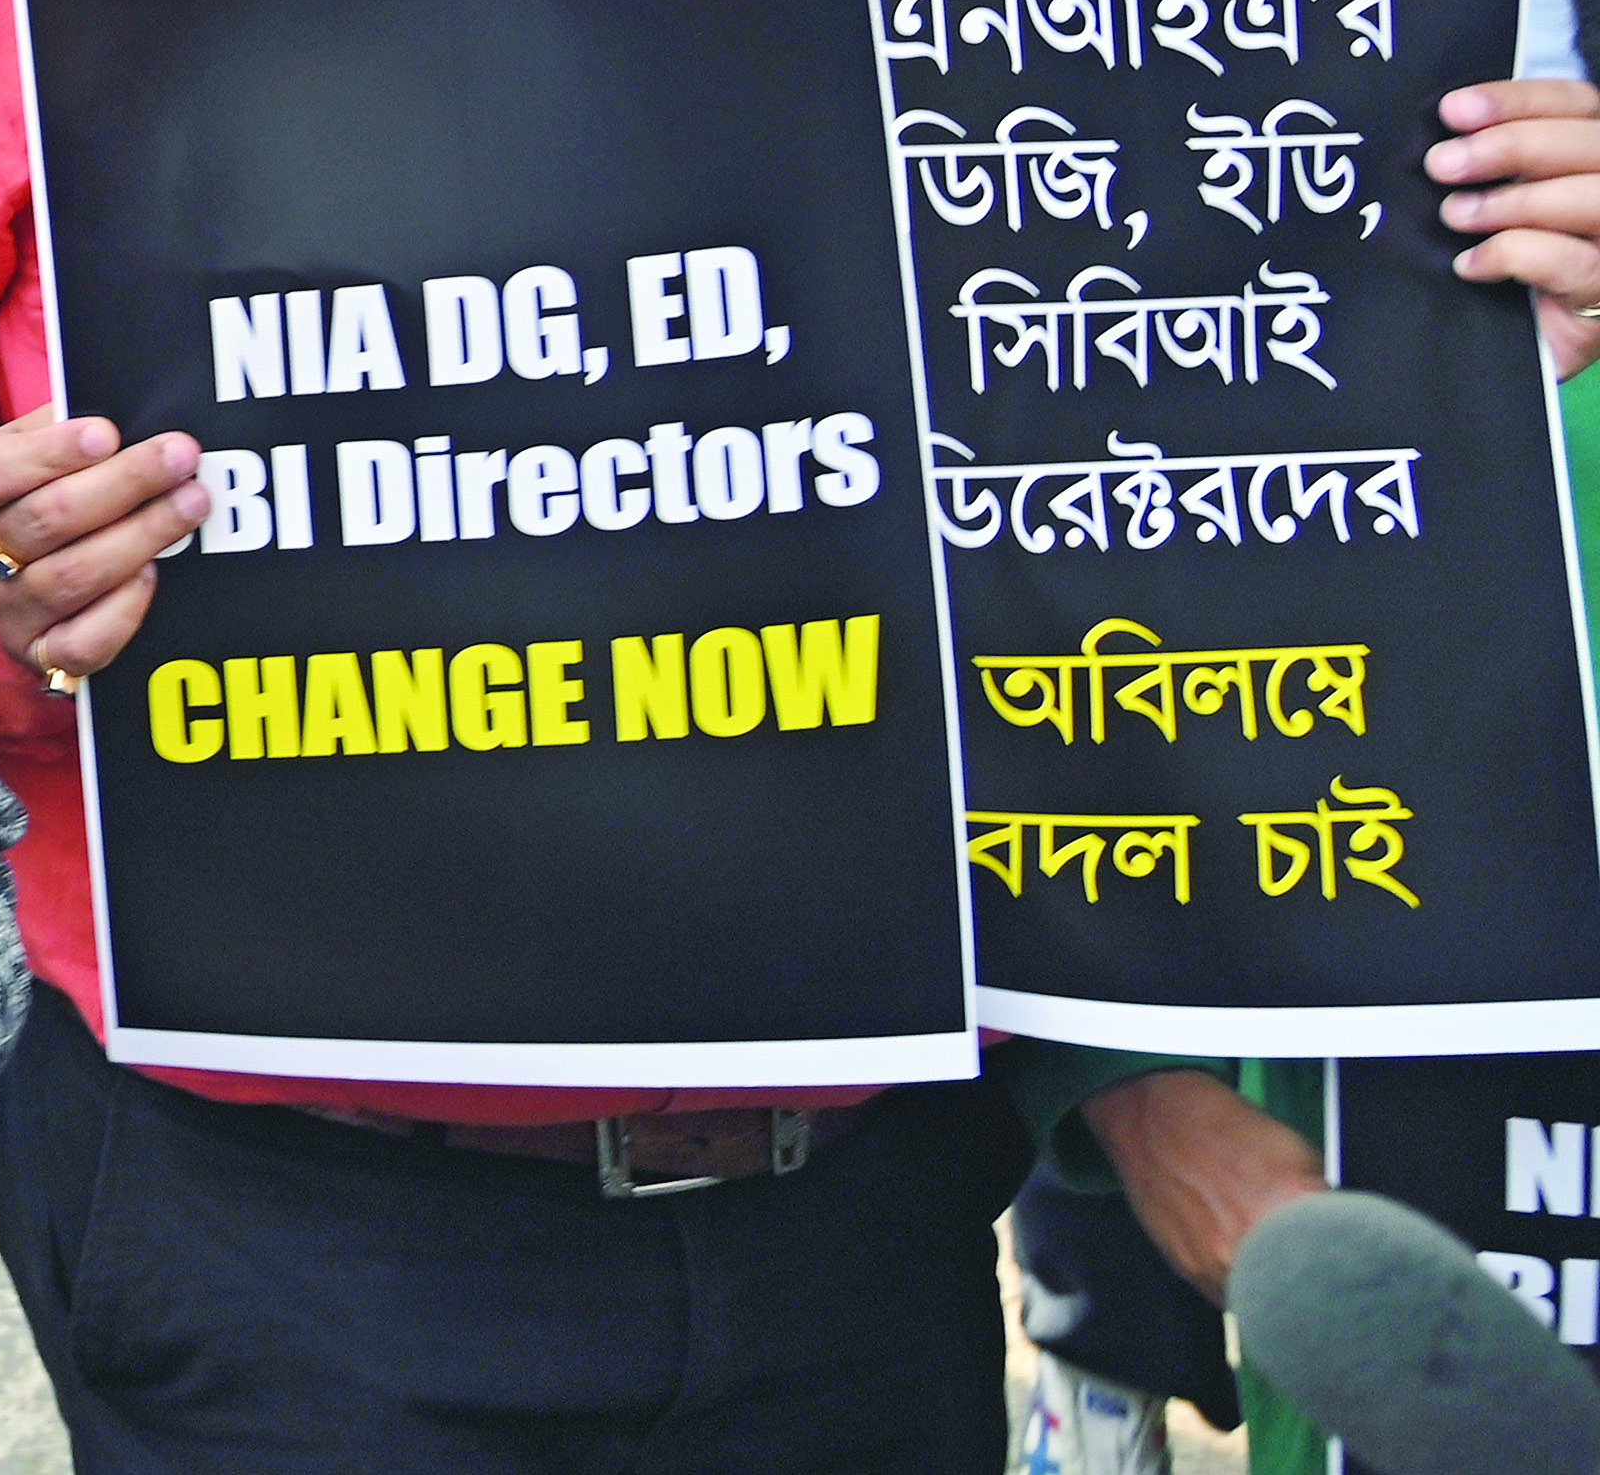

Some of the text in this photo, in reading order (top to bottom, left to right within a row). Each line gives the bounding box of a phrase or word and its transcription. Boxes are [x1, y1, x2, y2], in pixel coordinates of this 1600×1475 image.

[891, 100, 1381, 248] ডিজি, ইডি,
[210, 247, 789, 402] NIA DG, ED,
[949, 260, 1337, 394] সিবিআই
[152, 413, 879, 559] BI Directors
[149, 615, 880, 763] CHANGE NOW
[973, 618, 1371, 744] অবিলম্বে
[967, 778, 1420, 907] বদল চাই
[1476, 1250, 1600, 1345] BI
